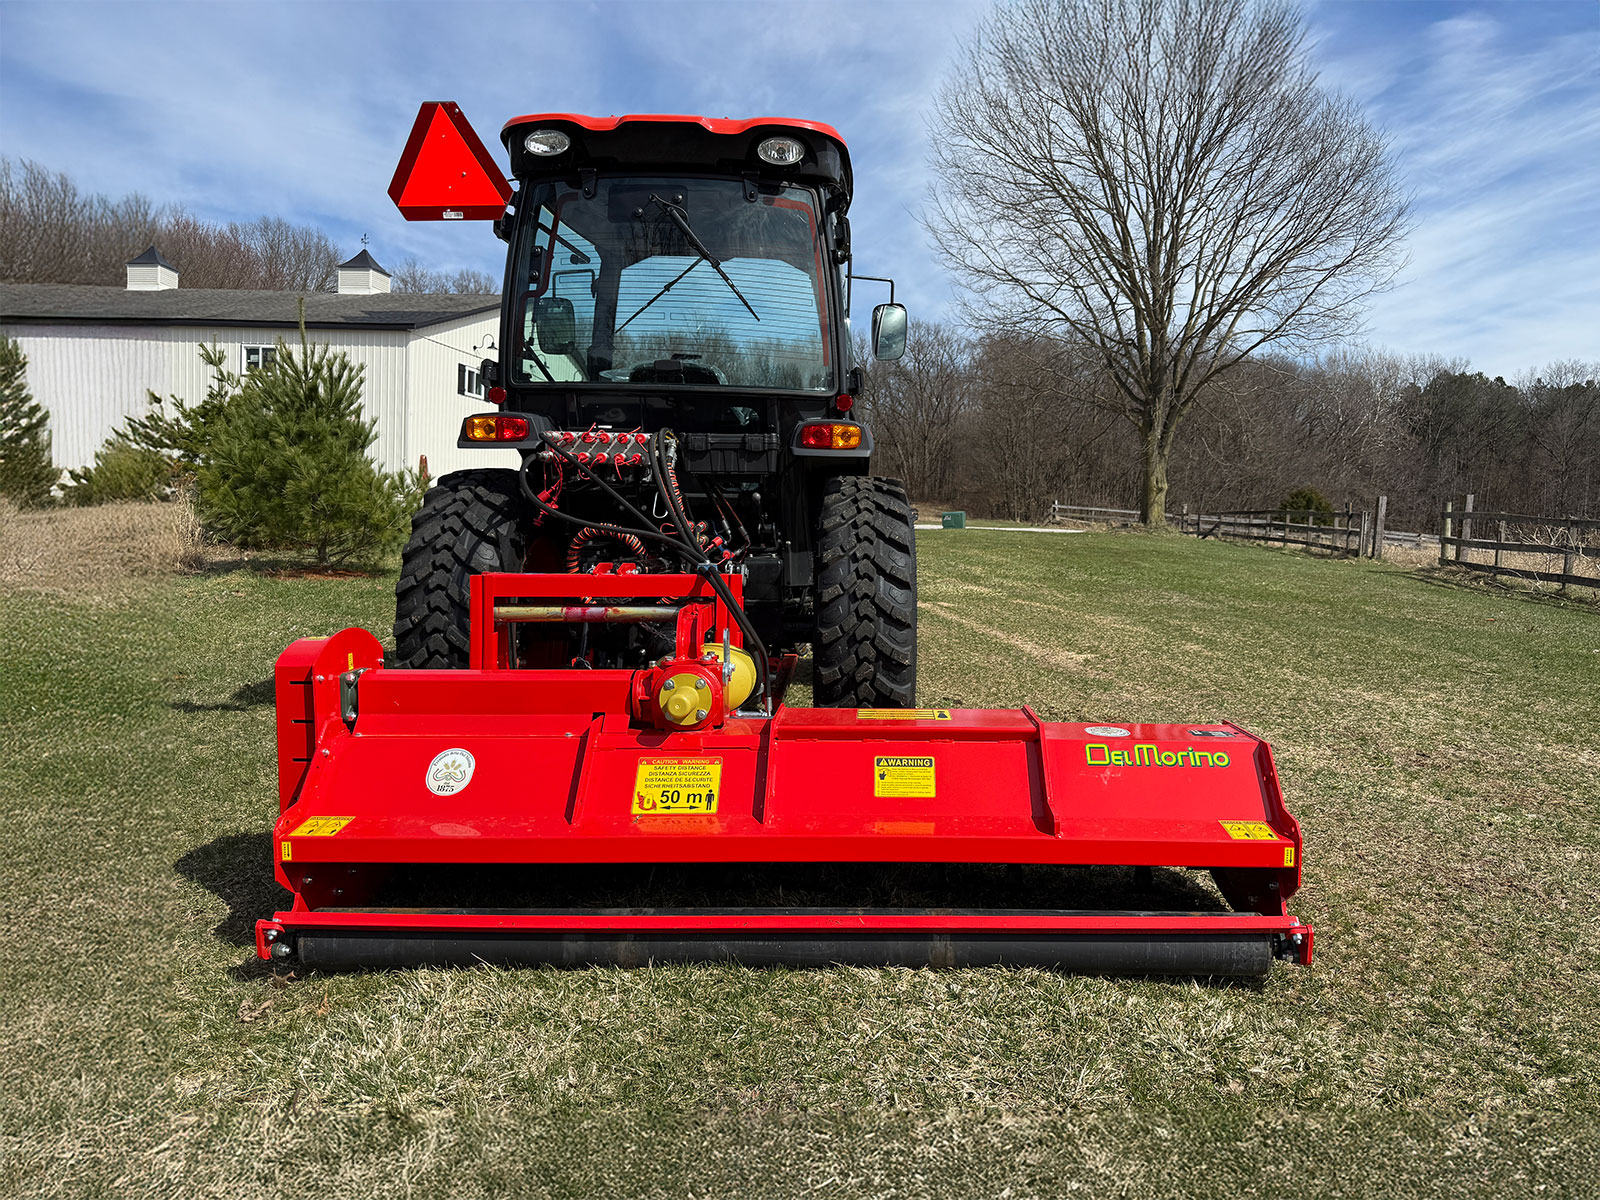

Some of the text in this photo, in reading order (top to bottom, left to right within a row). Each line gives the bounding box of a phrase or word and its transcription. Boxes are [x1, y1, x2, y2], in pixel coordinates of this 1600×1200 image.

[888, 758, 930, 766] WARNING
[436, 784, 455, 792] 1875
[660, 790, 702, 804] 50 m
